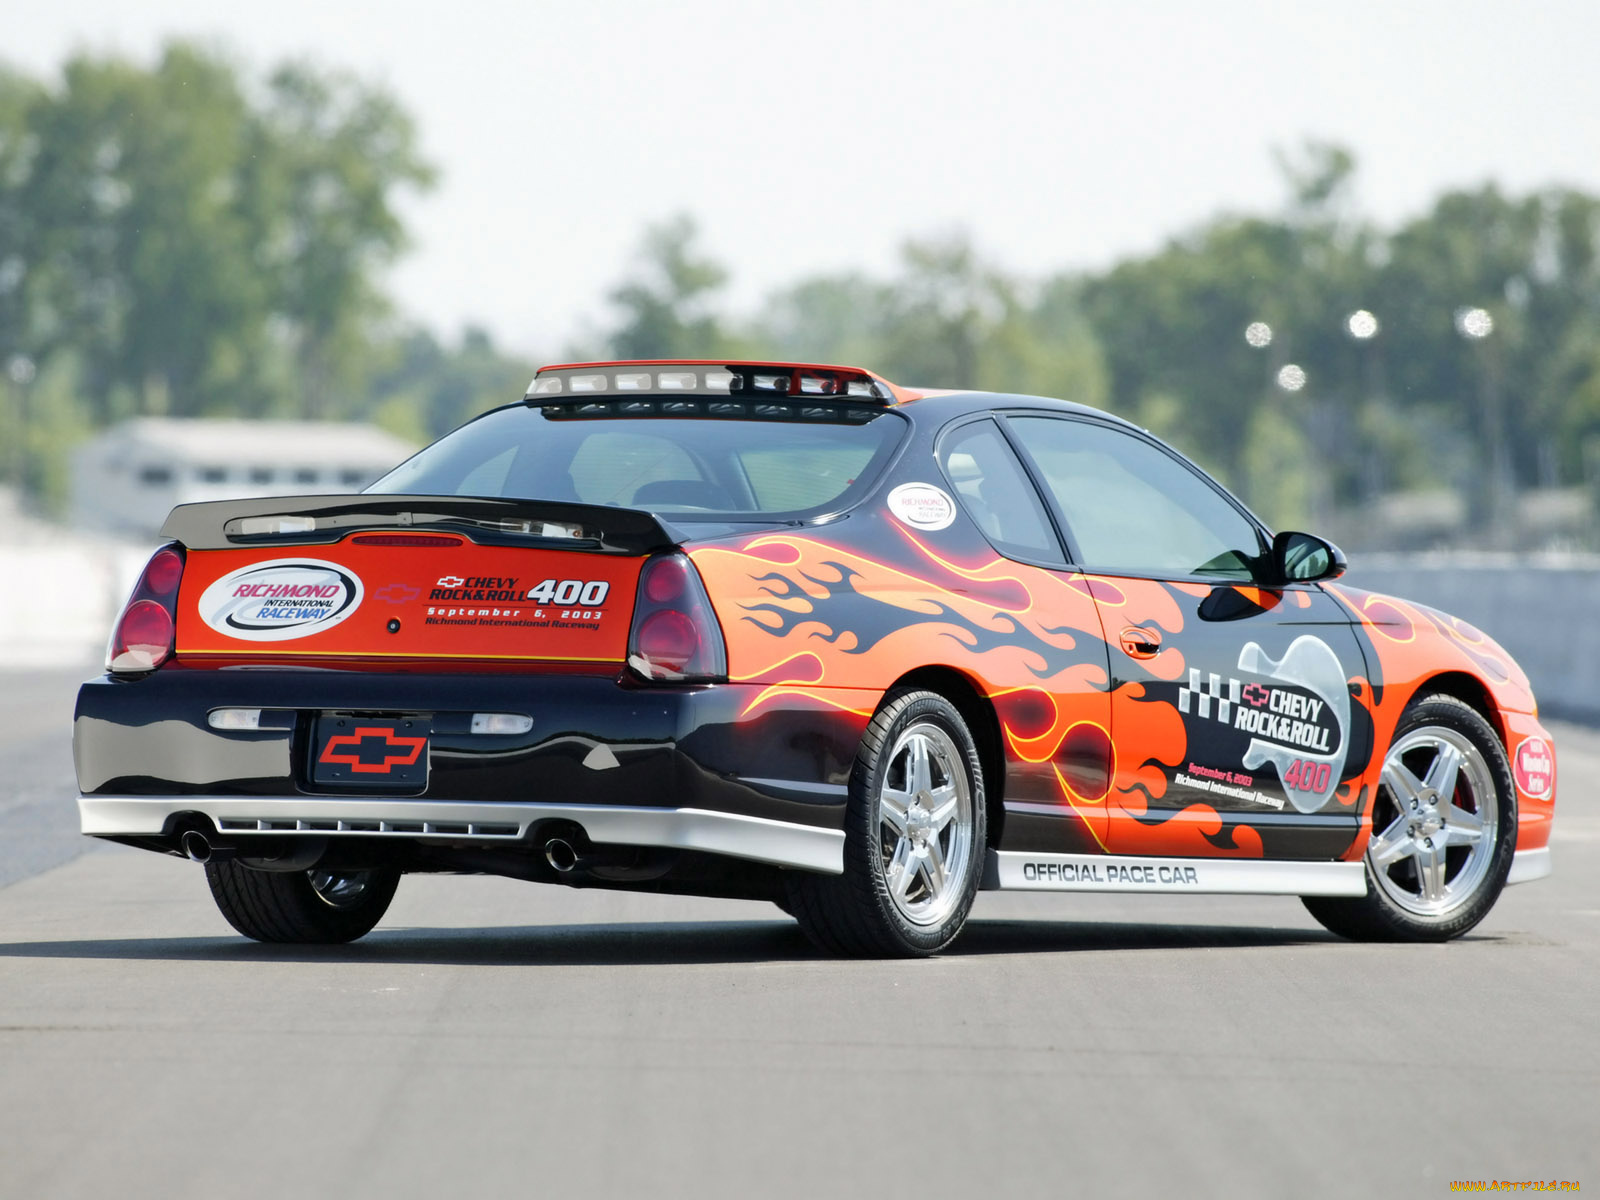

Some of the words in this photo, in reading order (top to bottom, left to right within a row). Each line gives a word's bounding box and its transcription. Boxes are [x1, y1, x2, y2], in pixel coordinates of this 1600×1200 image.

[232, 584, 340, 598] RICHMOND
[429, 588, 528, 602] ROCK&ROLL
[526, 579, 610, 606] 400
[464, 577, 519, 589] CHEVY
[256, 607, 332, 619] RACEWAY
[264, 599, 334, 607] INTERNATIONAL
[427, 607, 520, 617] September
[534, 609, 546, 619] 6,
[561, 610, 602, 619] 2003
[425, 617, 477, 625] Richmond
[478, 618, 550, 628] International
[551, 620, 600, 630] Raceway
[1269, 689, 1323, 722] CHEVY
[1234, 706, 1330, 752] ROCK&ROLL
[1188, 762, 1227, 780] September
[1226, 771, 1233, 784] 6,
[1234, 774, 1253, 787] 2003
[1284, 759, 1332, 793] 400
[1175, 773, 1211, 791] Richmond
[1210, 781, 1257, 802] International
[1255, 792, 1285, 811] Raceway
[1023, 862, 1104, 882] OFFICIAL
[1106, 865, 1156, 883] PACE
[1158, 867, 1198, 884] CAR
